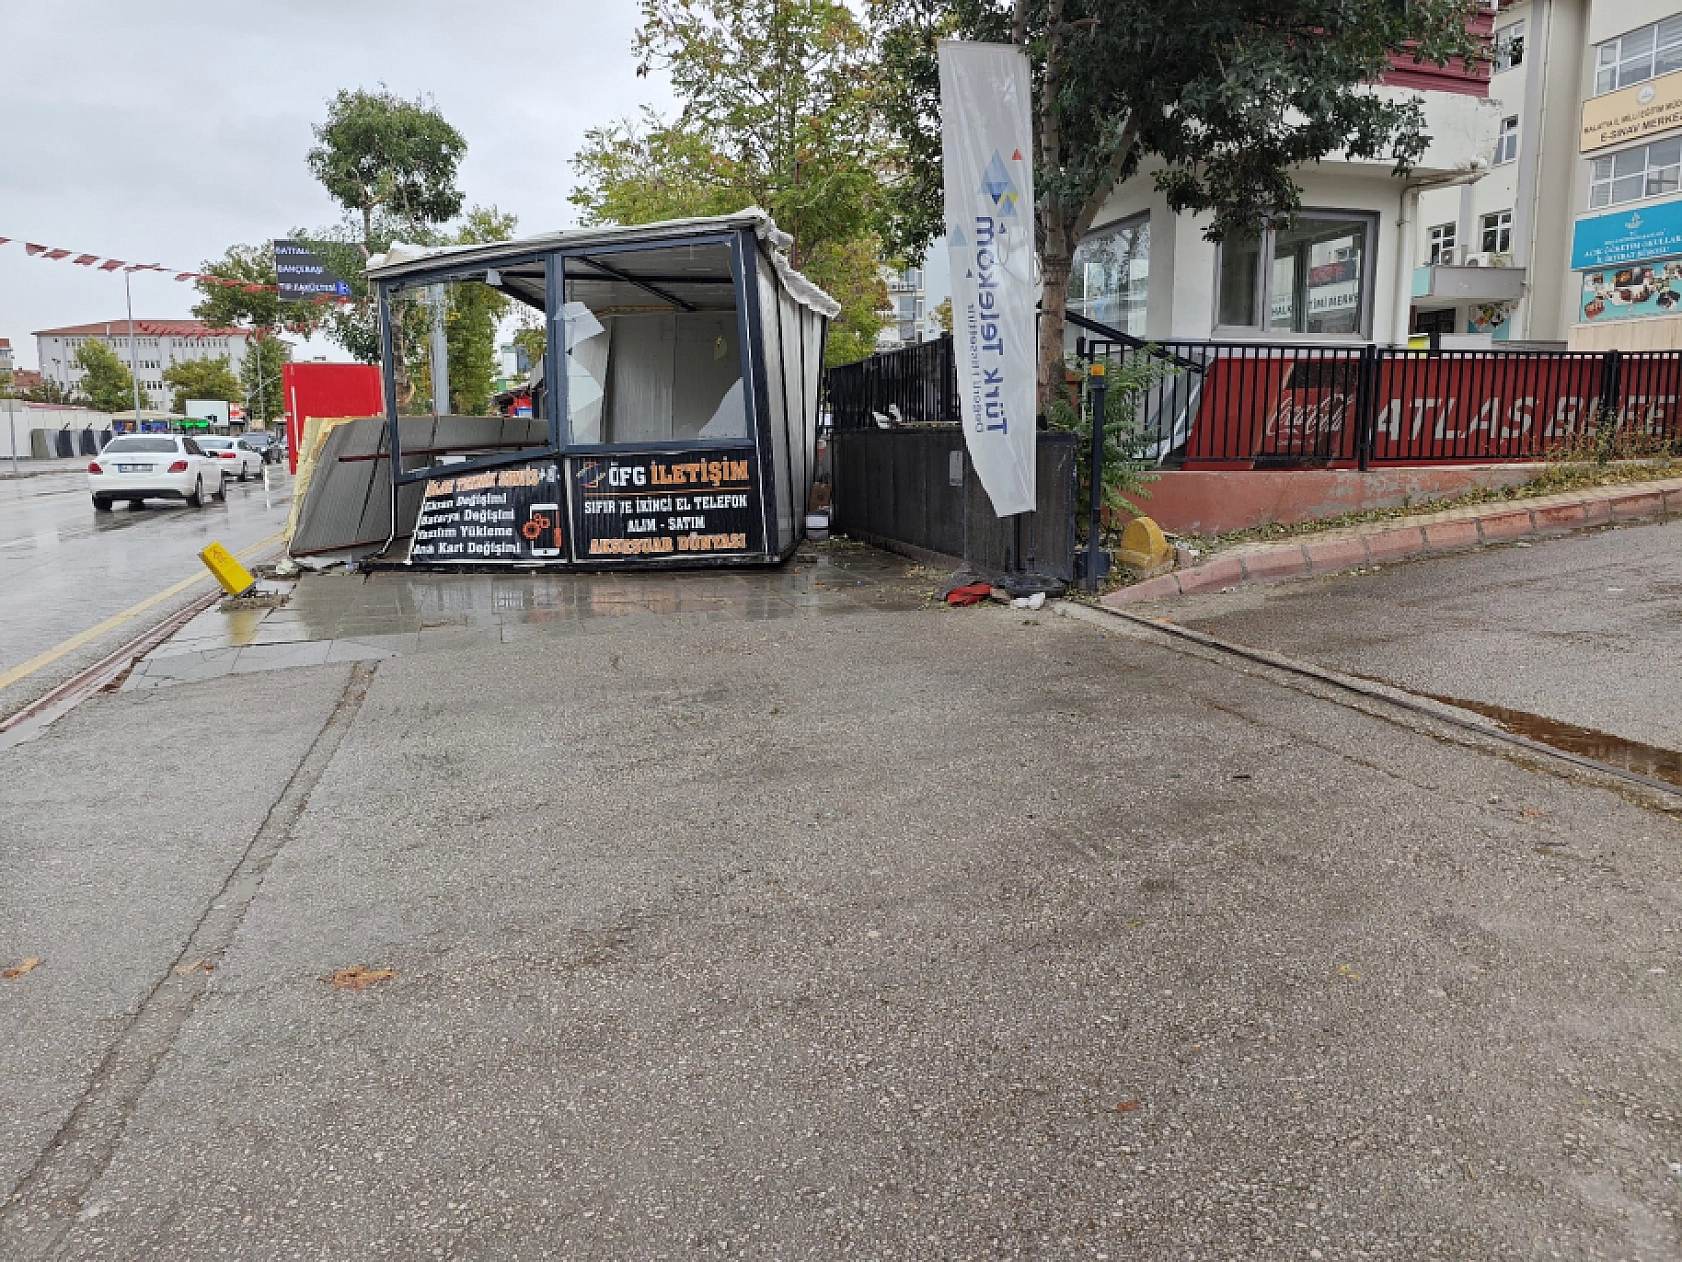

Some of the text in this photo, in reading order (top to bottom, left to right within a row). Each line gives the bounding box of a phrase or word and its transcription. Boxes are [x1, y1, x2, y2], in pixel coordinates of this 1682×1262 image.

[1367, 396, 1540, 441] ATLAS
[608, 456, 749, 486] ÖFG İLETİŞİM
[584, 500, 616, 514] SIFIR
[675, 497, 692, 510] EL
[693, 494, 748, 509] TELEFON
[460, 525, 513, 537] Yükleme
[437, 542, 464, 555] Kart
[466, 541, 521, 556] Değişimi
[588, 531, 747, 555] AKSESUAR DÜNYASI
